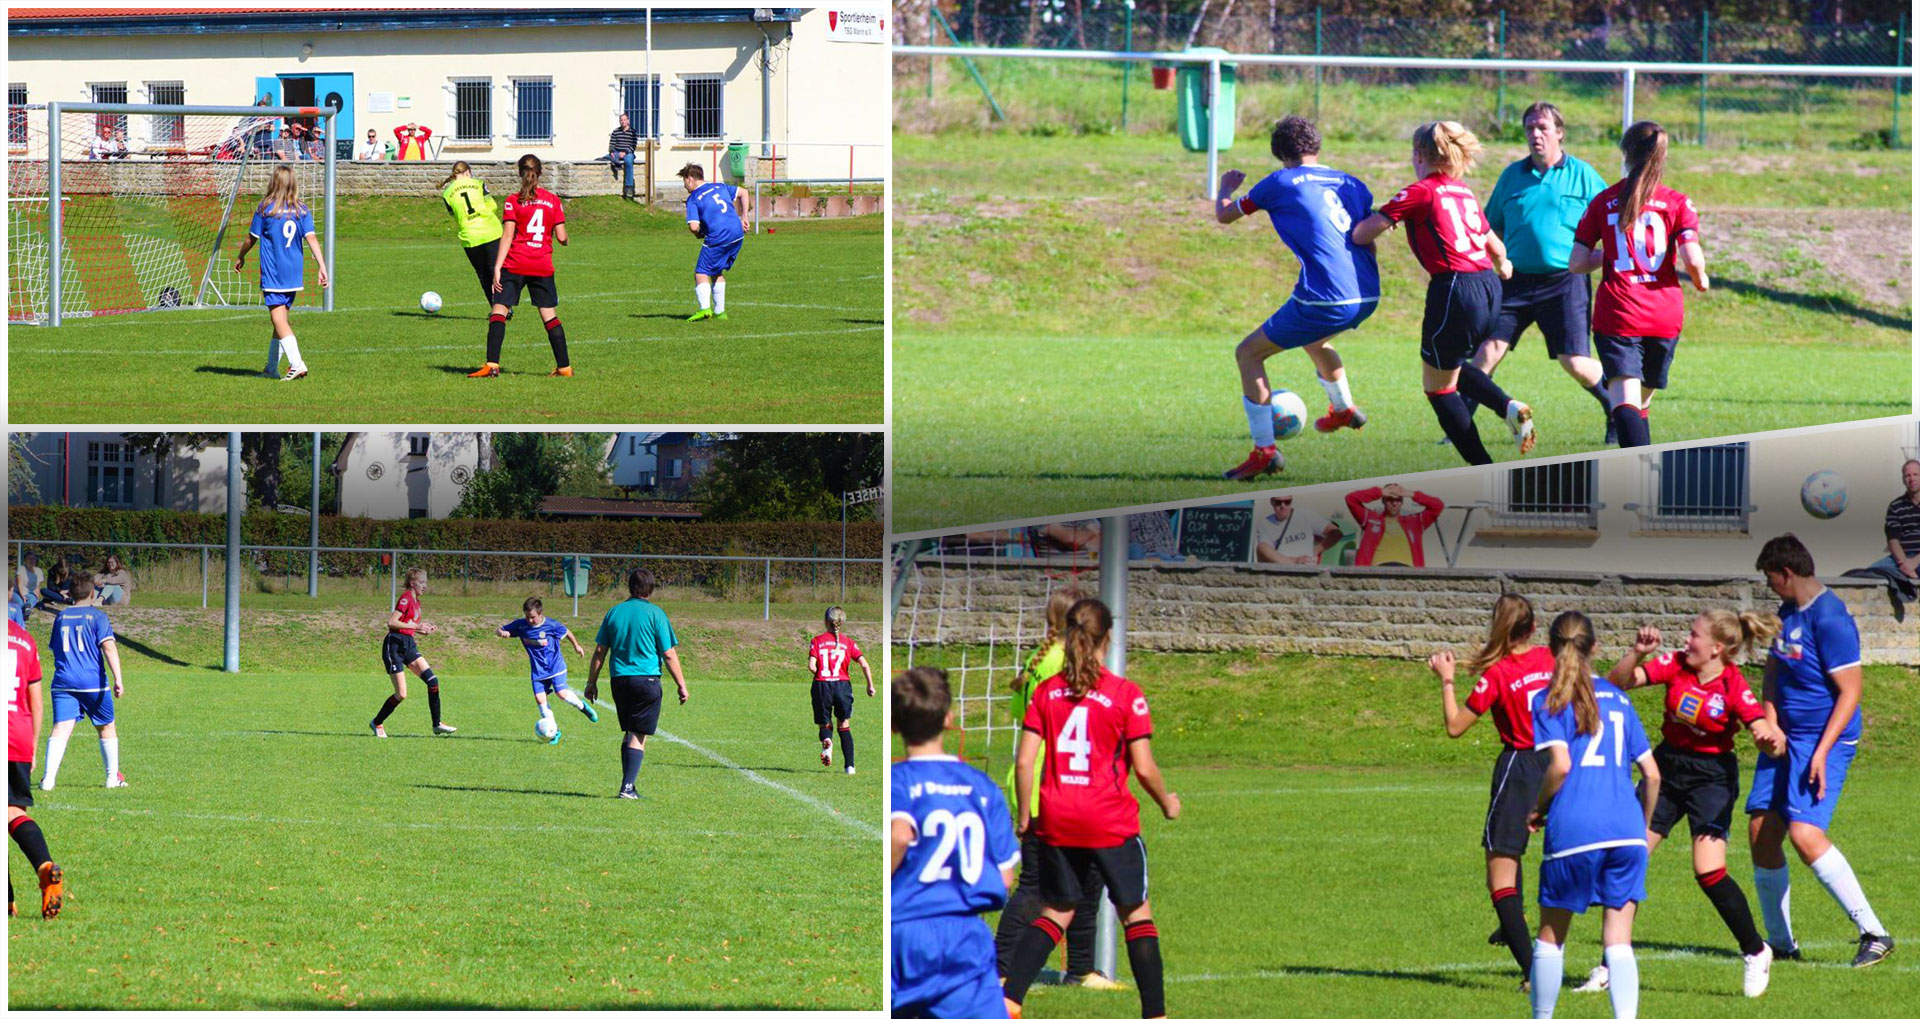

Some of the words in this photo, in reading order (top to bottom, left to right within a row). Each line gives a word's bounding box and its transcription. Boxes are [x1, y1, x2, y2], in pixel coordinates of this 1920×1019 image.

[840, 11, 877, 24] Sportlerheim
[460, 191, 476, 215] 1
[712, 193, 728, 214] 5
[1323, 188, 1352, 233] 8
[283, 220, 297, 248] 9
[526, 208, 546, 242] 4
[1441, 197, 1488, 253] 15
[1607, 211, 1668, 273] 10
[1285, 532, 1306, 544] JAKO
[61, 625, 85, 652] 11
[819, 648, 846, 677] 17
[1048, 688, 1063, 700] FC
[1057, 706, 1092, 772] 4
[1580, 710, 1625, 768] 21
[918, 808, 986, 886] 20
